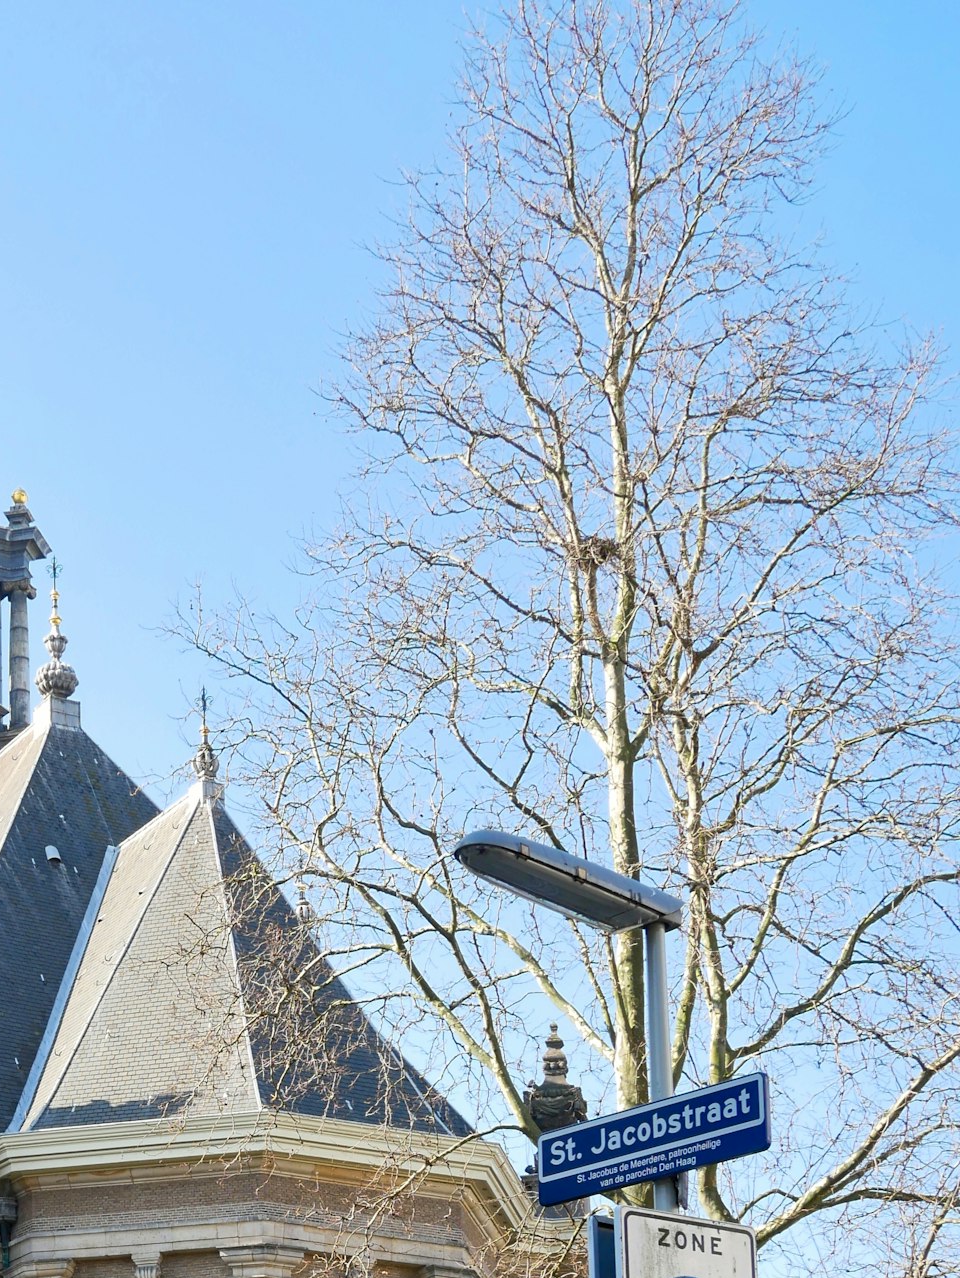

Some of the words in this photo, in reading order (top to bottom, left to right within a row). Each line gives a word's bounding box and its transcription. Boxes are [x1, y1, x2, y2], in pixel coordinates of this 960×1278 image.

[550, 1136, 583, 1166] St.
[590, 1088, 752, 1155] Jacobstraat
[587, 1166, 618, 1181] Jacobus
[619, 1162, 629, 1172] de
[630, 1153, 668, 1169] Meerdere,
[668, 1139, 722, 1161] patroonheilige
[600, 1178, 614, 1187] van
[614, 1174, 625, 1183] de
[625, 1165, 658, 1183] parochie
[659, 1162, 674, 1172] Den
[675, 1156, 697, 1168] Haag
[657, 1227, 723, 1256] ZONE
